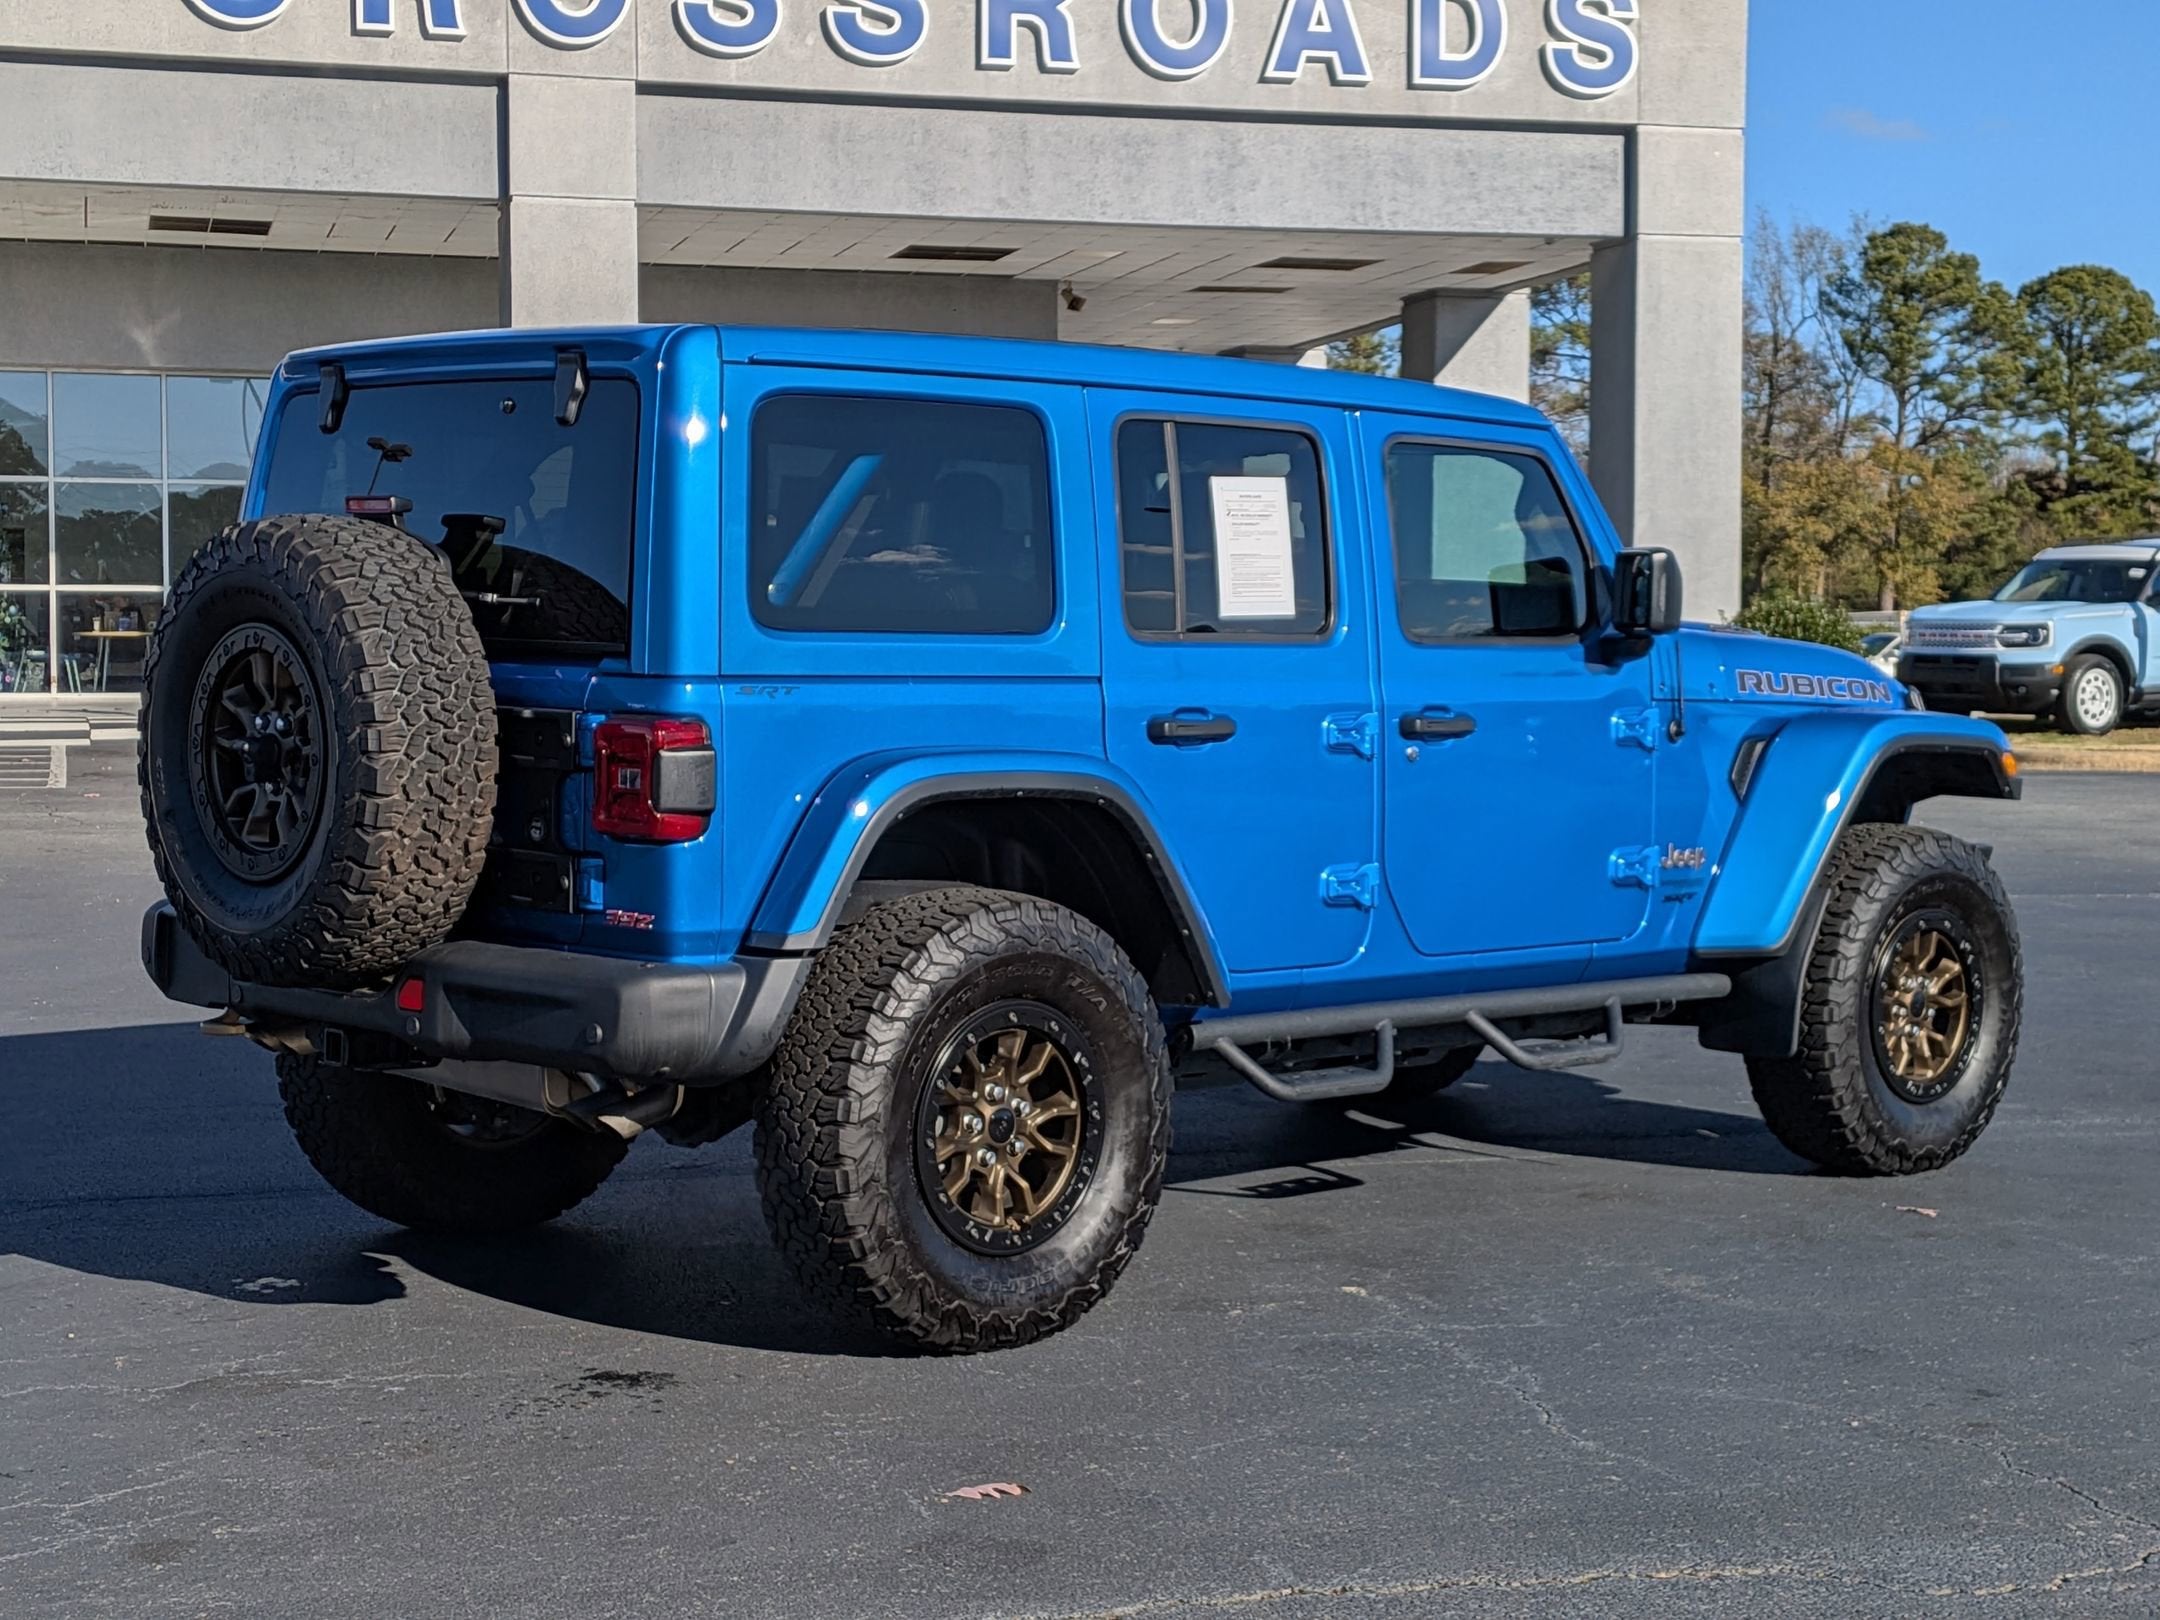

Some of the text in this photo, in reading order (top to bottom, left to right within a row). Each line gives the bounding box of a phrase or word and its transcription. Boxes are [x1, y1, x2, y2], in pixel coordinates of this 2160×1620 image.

[182, 0, 1641, 99] SROADS
[735, 685, 801, 700] SRT
[1735, 668, 1893, 704] RUBICON
[1660, 842, 1706, 872] Jeep
[605, 908, 656, 929] 392
